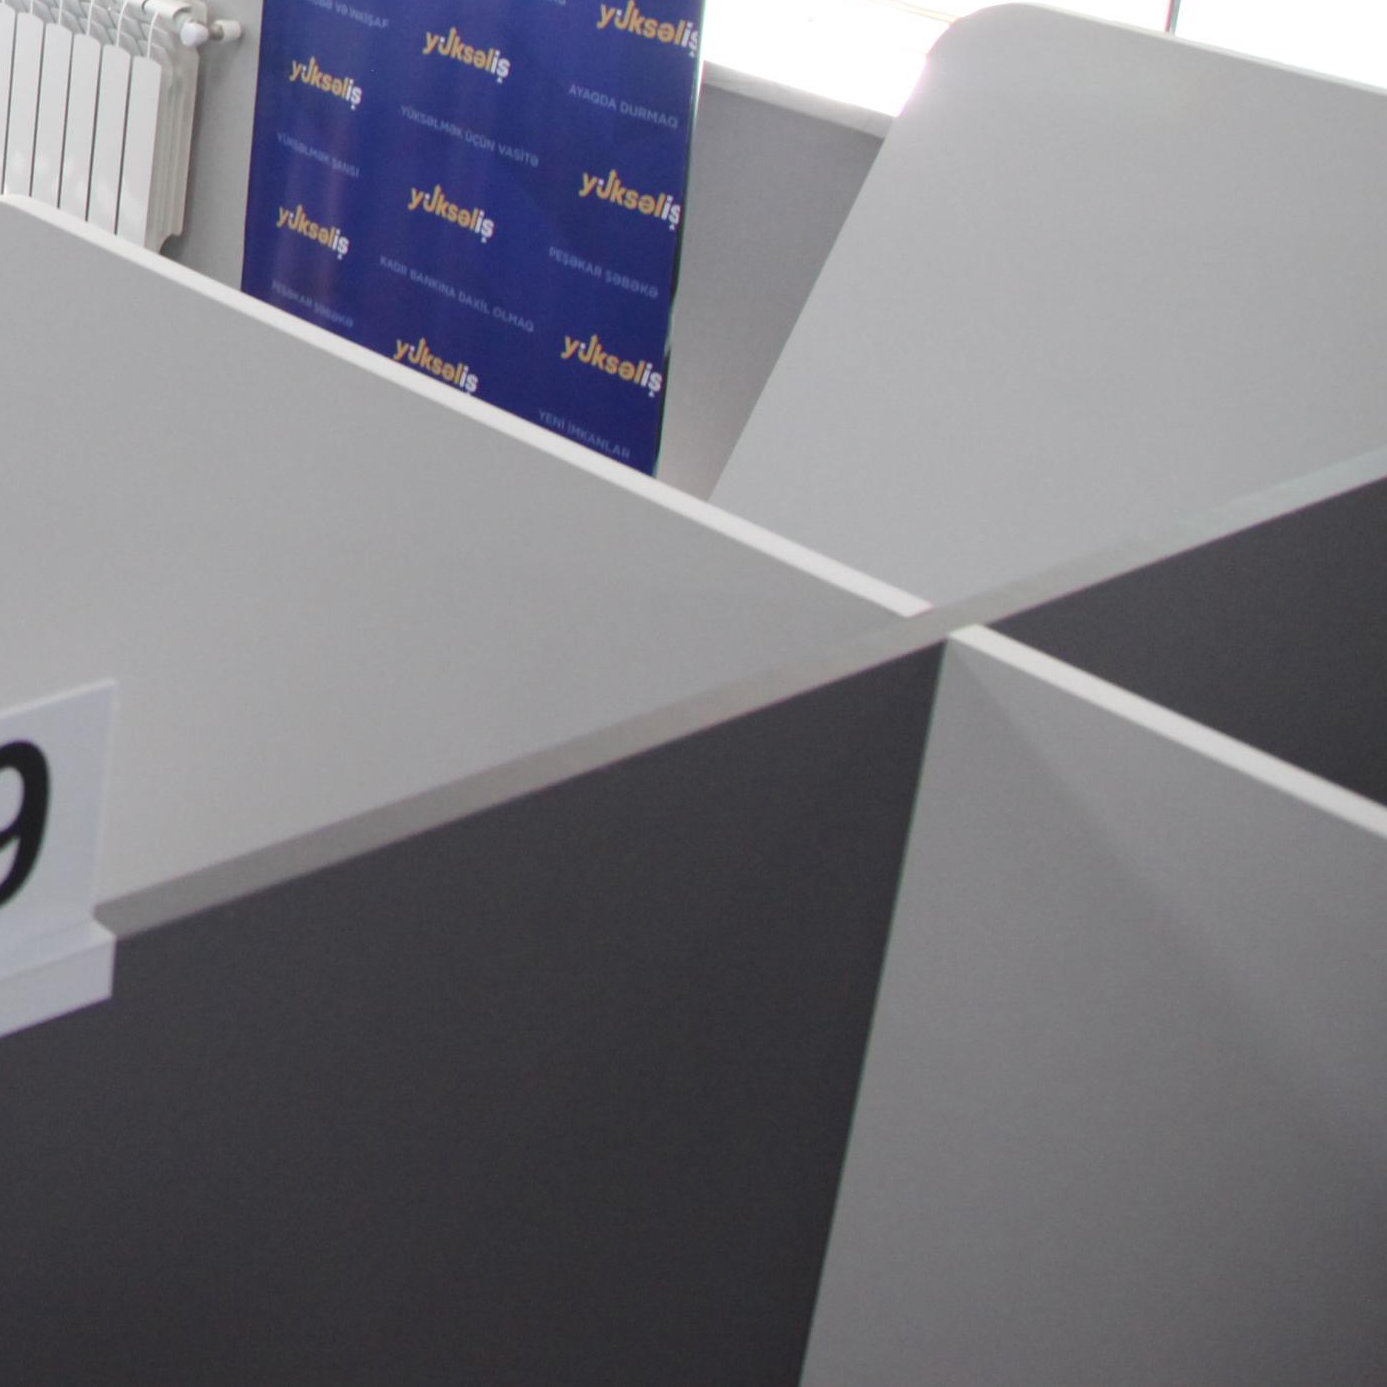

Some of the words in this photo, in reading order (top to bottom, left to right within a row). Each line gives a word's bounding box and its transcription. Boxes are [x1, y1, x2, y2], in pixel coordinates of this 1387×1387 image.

[422, 26, 511, 84] yüksəliş
[465, 127, 495, 152] ÜÇÜN
[620, 100, 678, 129] DURMAQ
[407, 184, 495, 244] yüksəliş
[578, 168, 681, 230] yüksəliş
[492, 305, 535, 333] OLMAQ
[560, 333, 664, 398] yüksəliş
